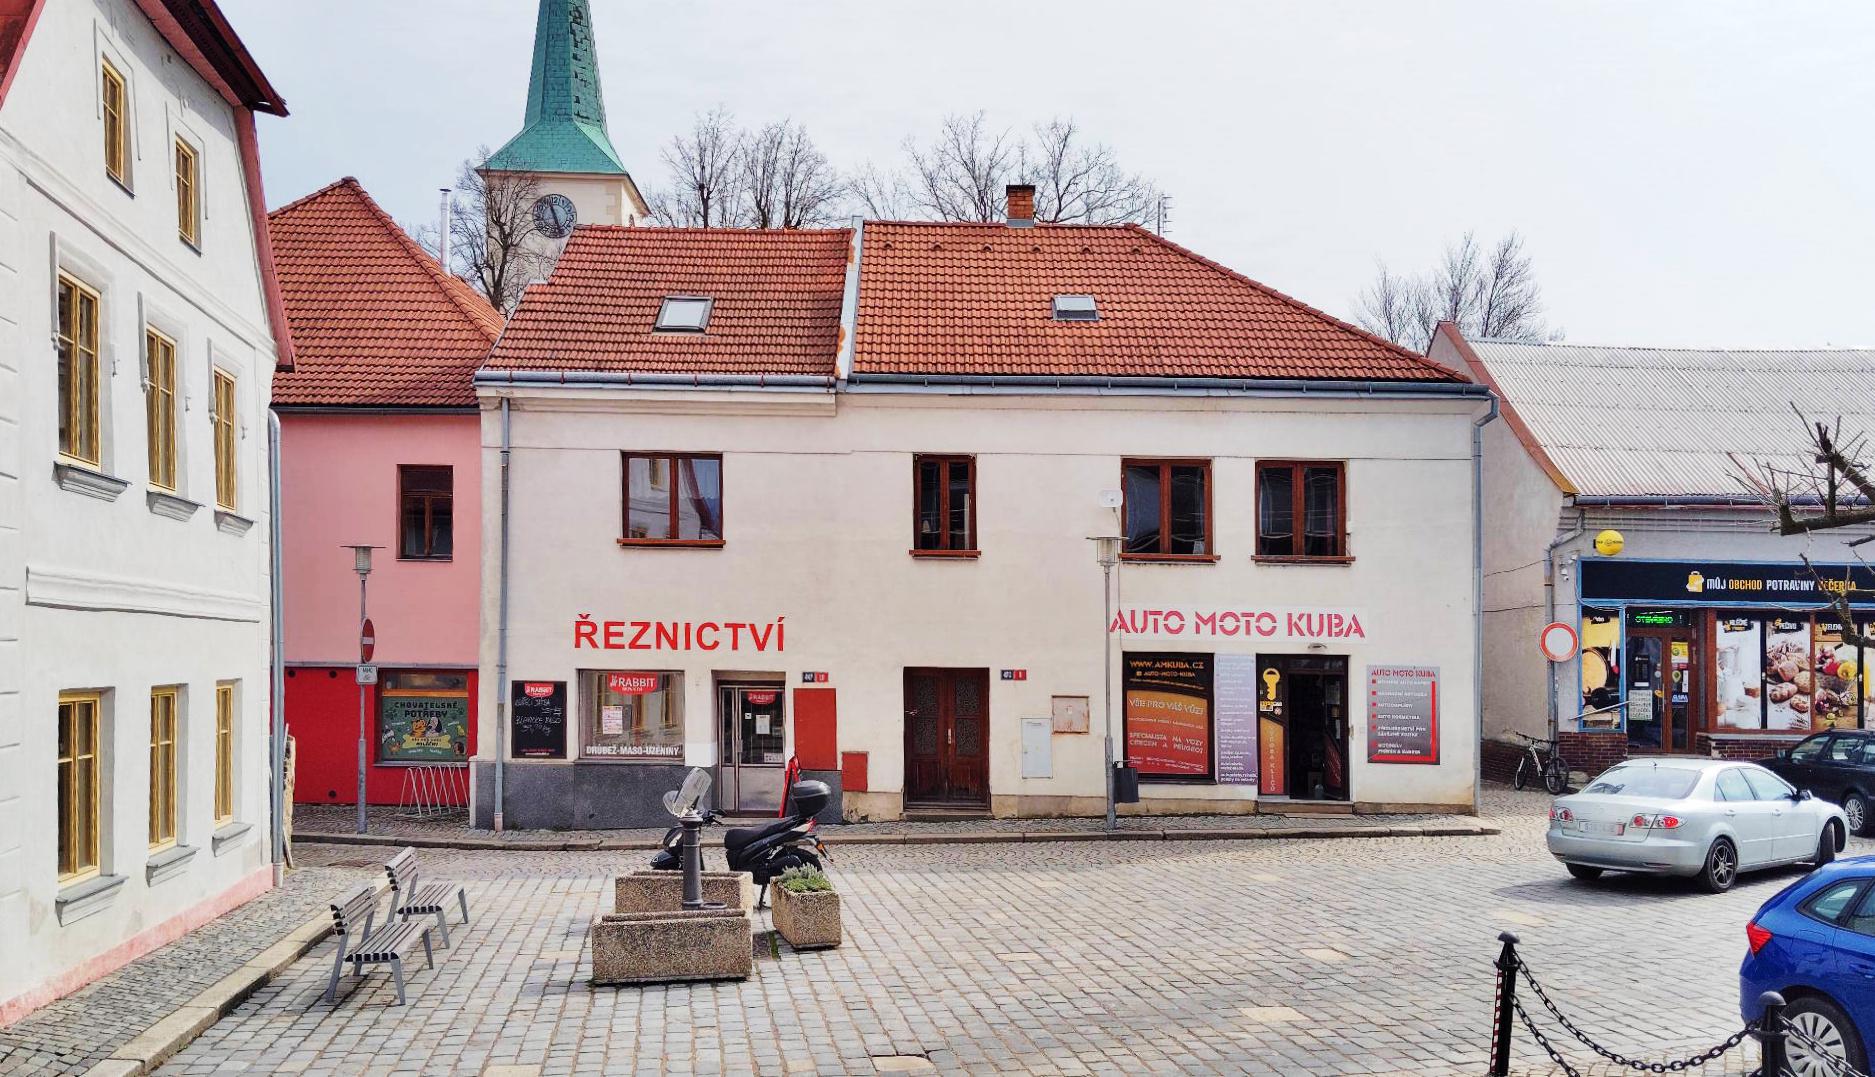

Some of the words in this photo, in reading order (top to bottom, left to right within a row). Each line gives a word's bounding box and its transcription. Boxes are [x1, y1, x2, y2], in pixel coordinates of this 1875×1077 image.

[1729, 579, 1762, 590] OBCHOD
[1766, 579, 1815, 590] POTRAVINY
[1110, 610, 1185, 634] AUTO
[1195, 612, 1277, 636] MOTO
[1288, 613, 1365, 638] KUBA
[575, 614, 785, 652] ŘEZNICTVÍ
[1130, 661, 1204, 669] WWW.AMKUBA.CZ
[619, 678, 655, 687] RABBIT
[395, 701, 458, 709] CHOVATELSKÉ
[1129, 698, 1146, 706] VŠE
[1147, 700, 1164, 708] PRO
[1166, 701, 1183, 712] VÁŠ
[404, 709, 448, 718] POTŘEBY
[1129, 732, 1167, 741] SPECIALISTA
[1186, 738, 1203, 746] VOZY
